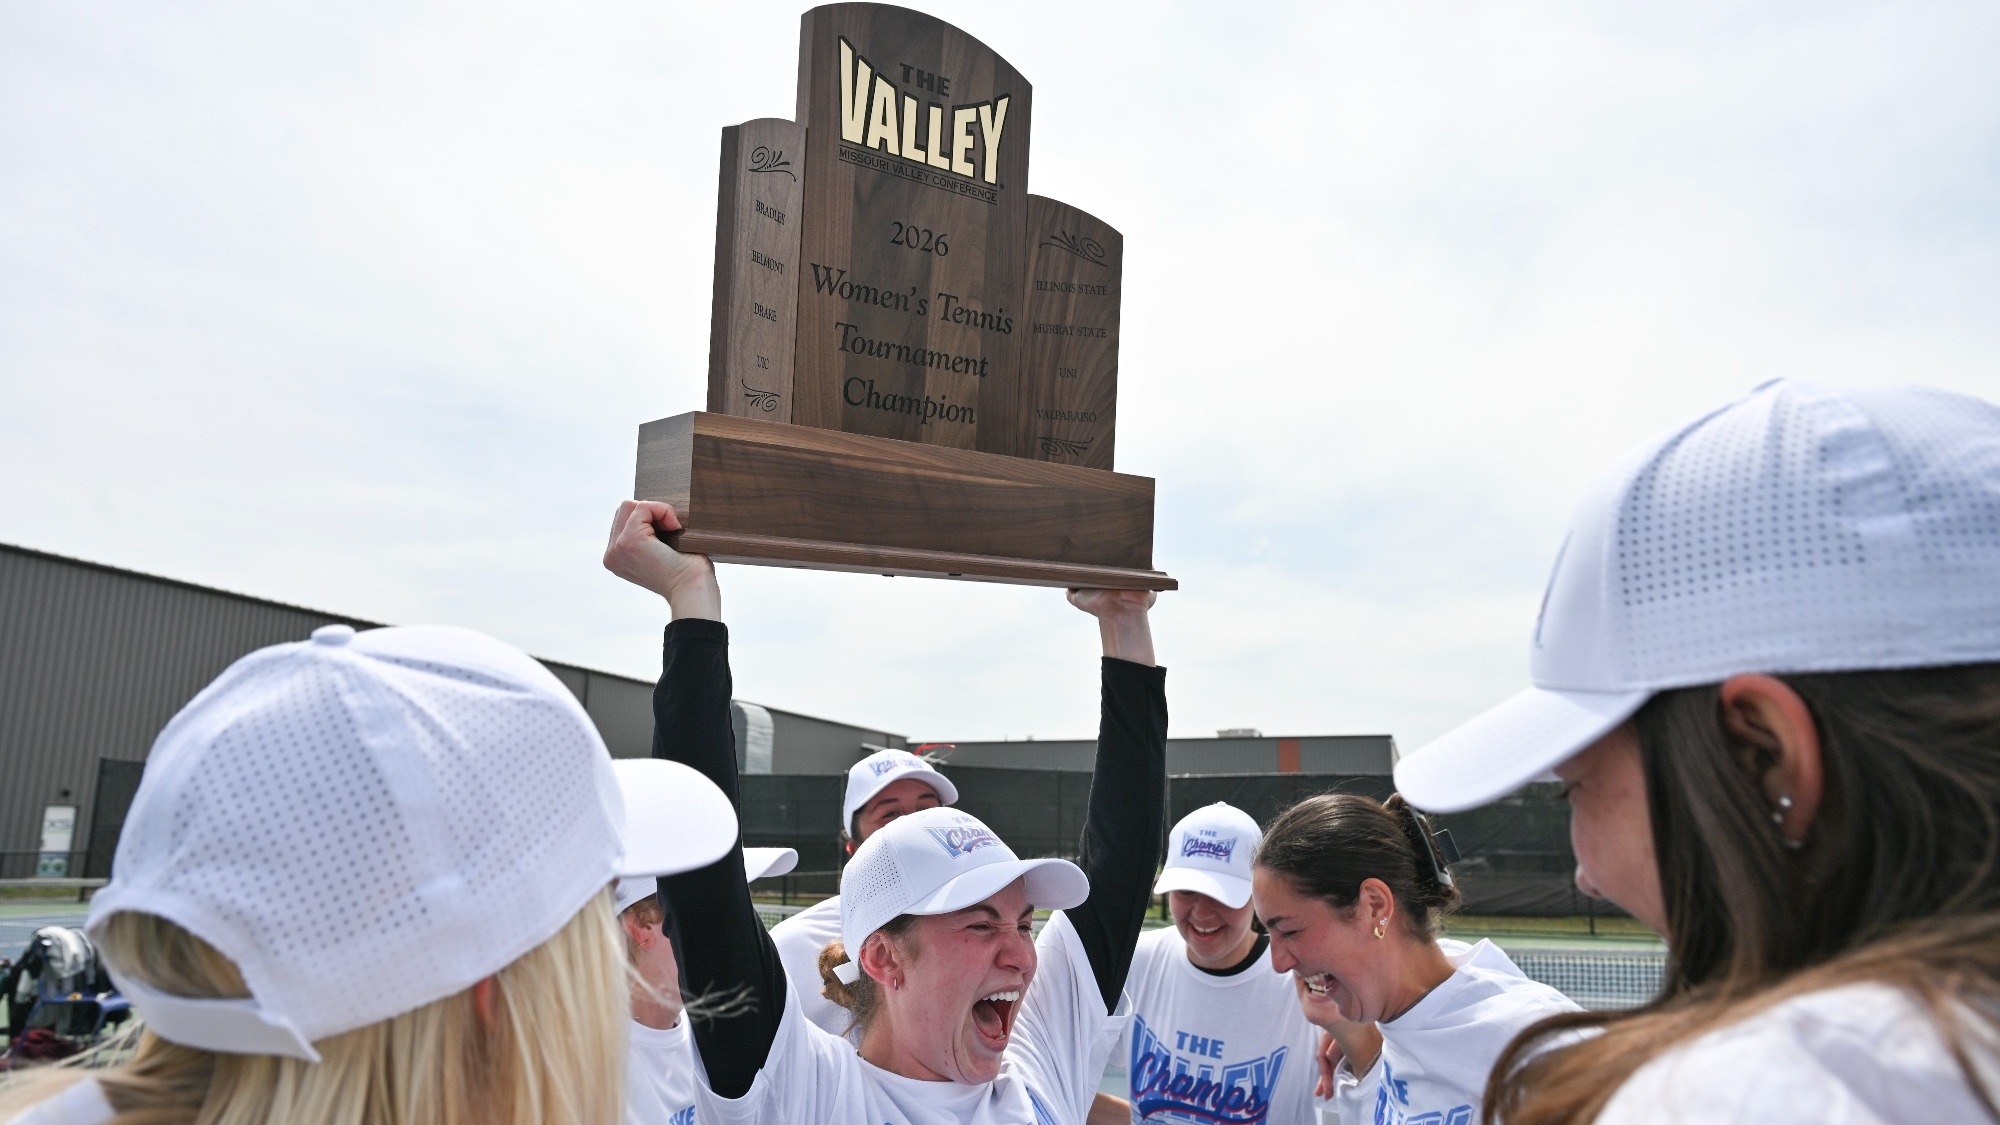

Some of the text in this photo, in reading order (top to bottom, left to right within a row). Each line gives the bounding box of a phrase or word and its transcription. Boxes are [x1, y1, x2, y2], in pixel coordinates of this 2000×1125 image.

[900, 62, 950, 97] THE
[838, 35, 1011, 186] VALLEY
[839, 147, 998, 202] MISSOURI VALLEY CONFERENCE
[756, 199, 786, 225] BRADLEY
[890, 221, 949, 256] 2026
[752, 249, 784, 275] BELMONT
[810, 263, 1014, 335] Women's Tennis
[1036, 280, 1108, 296] ILLINOIS STATE
[754, 302, 777, 322] DRAKE
[1033, 323, 1107, 339] MURRAY STATE
[834, 321, 989, 378] Tournament
[1059, 367, 1077, 379] UNI
[843, 377, 976, 425] Champion
[1037, 408, 1097, 423] VALPARAISO
[1199, 829, 1218, 837] THE
[1183, 838, 1231, 857] Champs
[1176, 1030, 1225, 1060] THE
[1131, 1051, 1269, 1122] Champs
